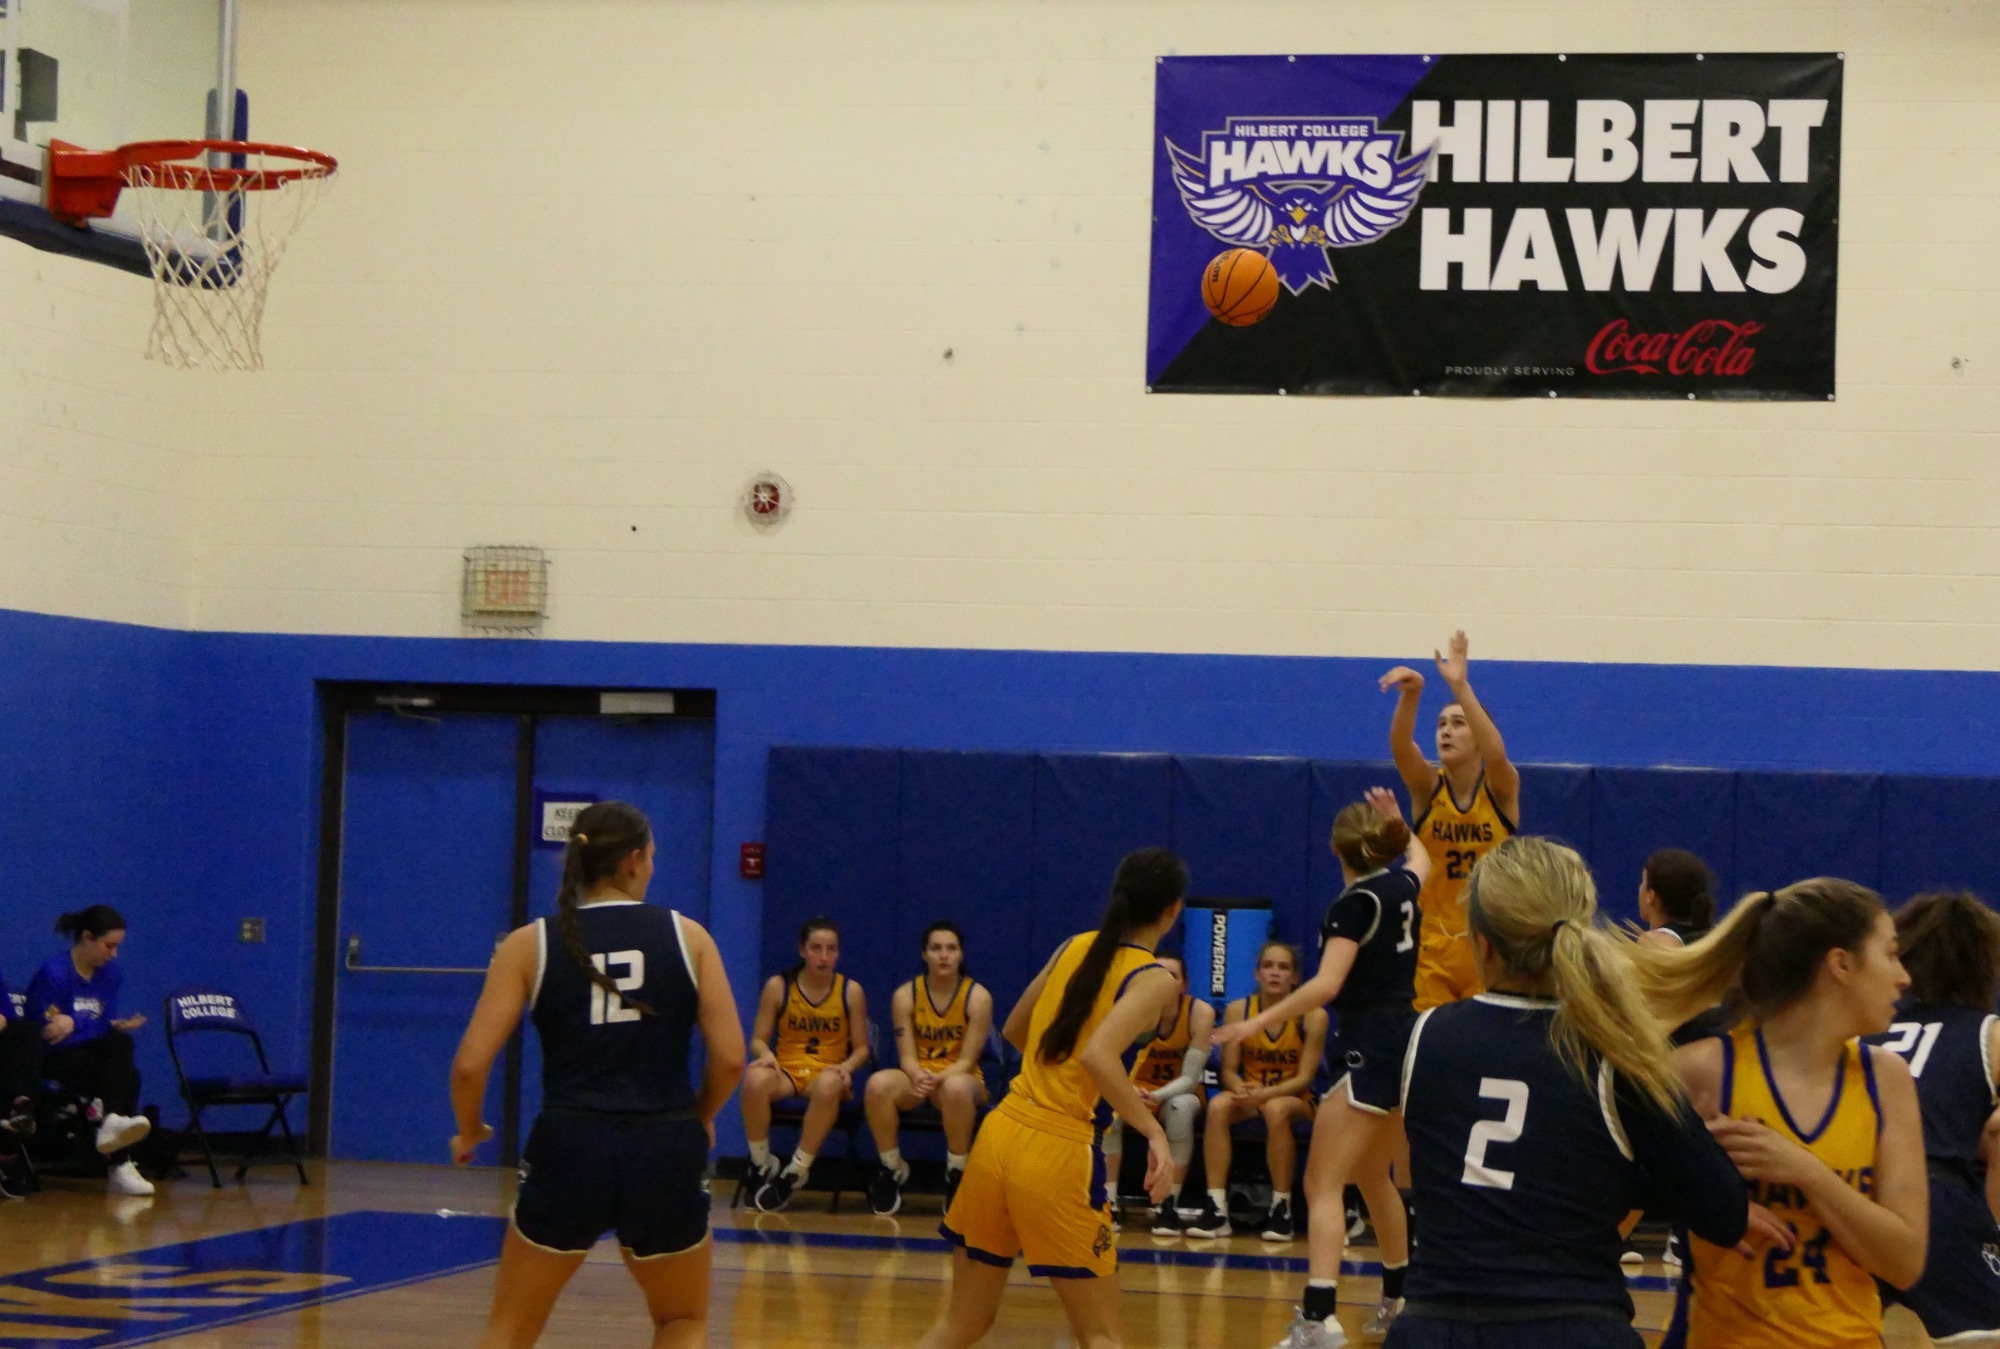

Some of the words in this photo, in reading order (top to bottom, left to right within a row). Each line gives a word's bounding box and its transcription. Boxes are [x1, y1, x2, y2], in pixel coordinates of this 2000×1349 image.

[1234, 124, 1298, 137] HILBERT
[1302, 124, 1369, 137] COLLEGE
[1412, 100, 1828, 183] HILBERT
[1208, 139, 1393, 189] HAWKS
[1419, 207, 1808, 294] HAWKS
[1445, 365, 1509, 376] PROUDLY
[1513, 366, 1576, 376] SERVING
[1432, 820, 1494, 843] HAWKS
[1396, 900, 1414, 953] 3
[1211, 914, 1227, 993] POWERADE
[177, 994, 234, 1008] HILBERT
[182, 1006, 236, 1019] COLLEGE
[589, 949, 645, 1025] 12
[788, 1014, 841, 1033] HAWKS
[805, 1036, 821, 1055] 2
[1880, 1021, 1944, 1078] 21
[1461, 1076, 1530, 1191] 2
[1764, 1217, 1832, 1288] 24
